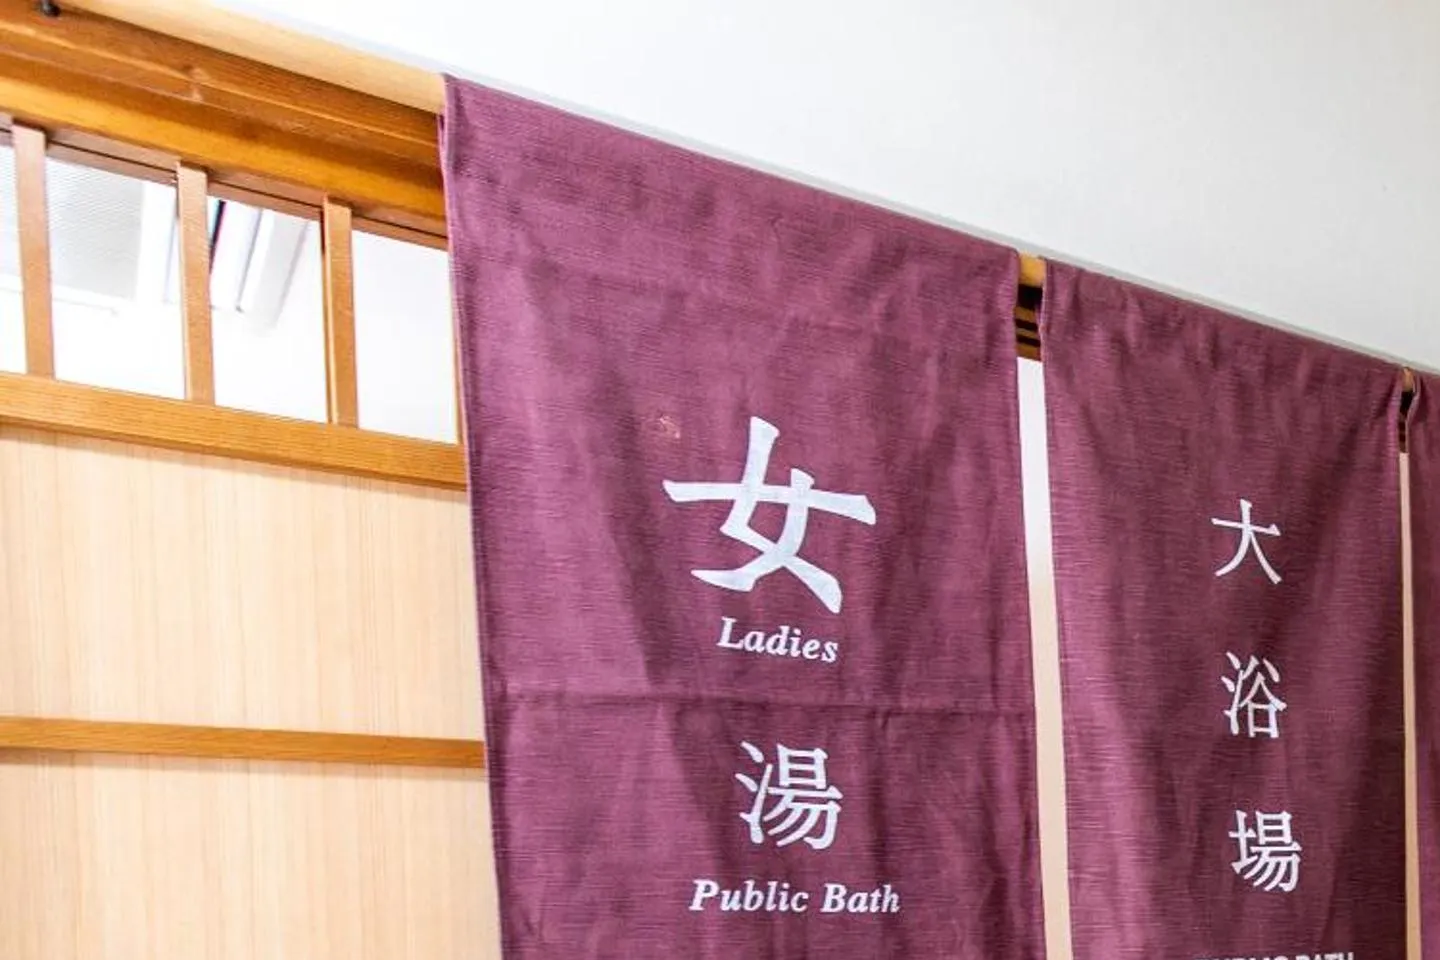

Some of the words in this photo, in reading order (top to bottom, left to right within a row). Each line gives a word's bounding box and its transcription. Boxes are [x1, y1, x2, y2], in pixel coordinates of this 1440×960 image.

[662, 416, 877, 614] 女
[717, 616, 839, 663] Ladies
[1211, 498, 1302, 892] 大浴場
[735, 741, 843, 850] 湯
[689, 879, 809, 913] Public
[820, 880, 900, 913] Bath
